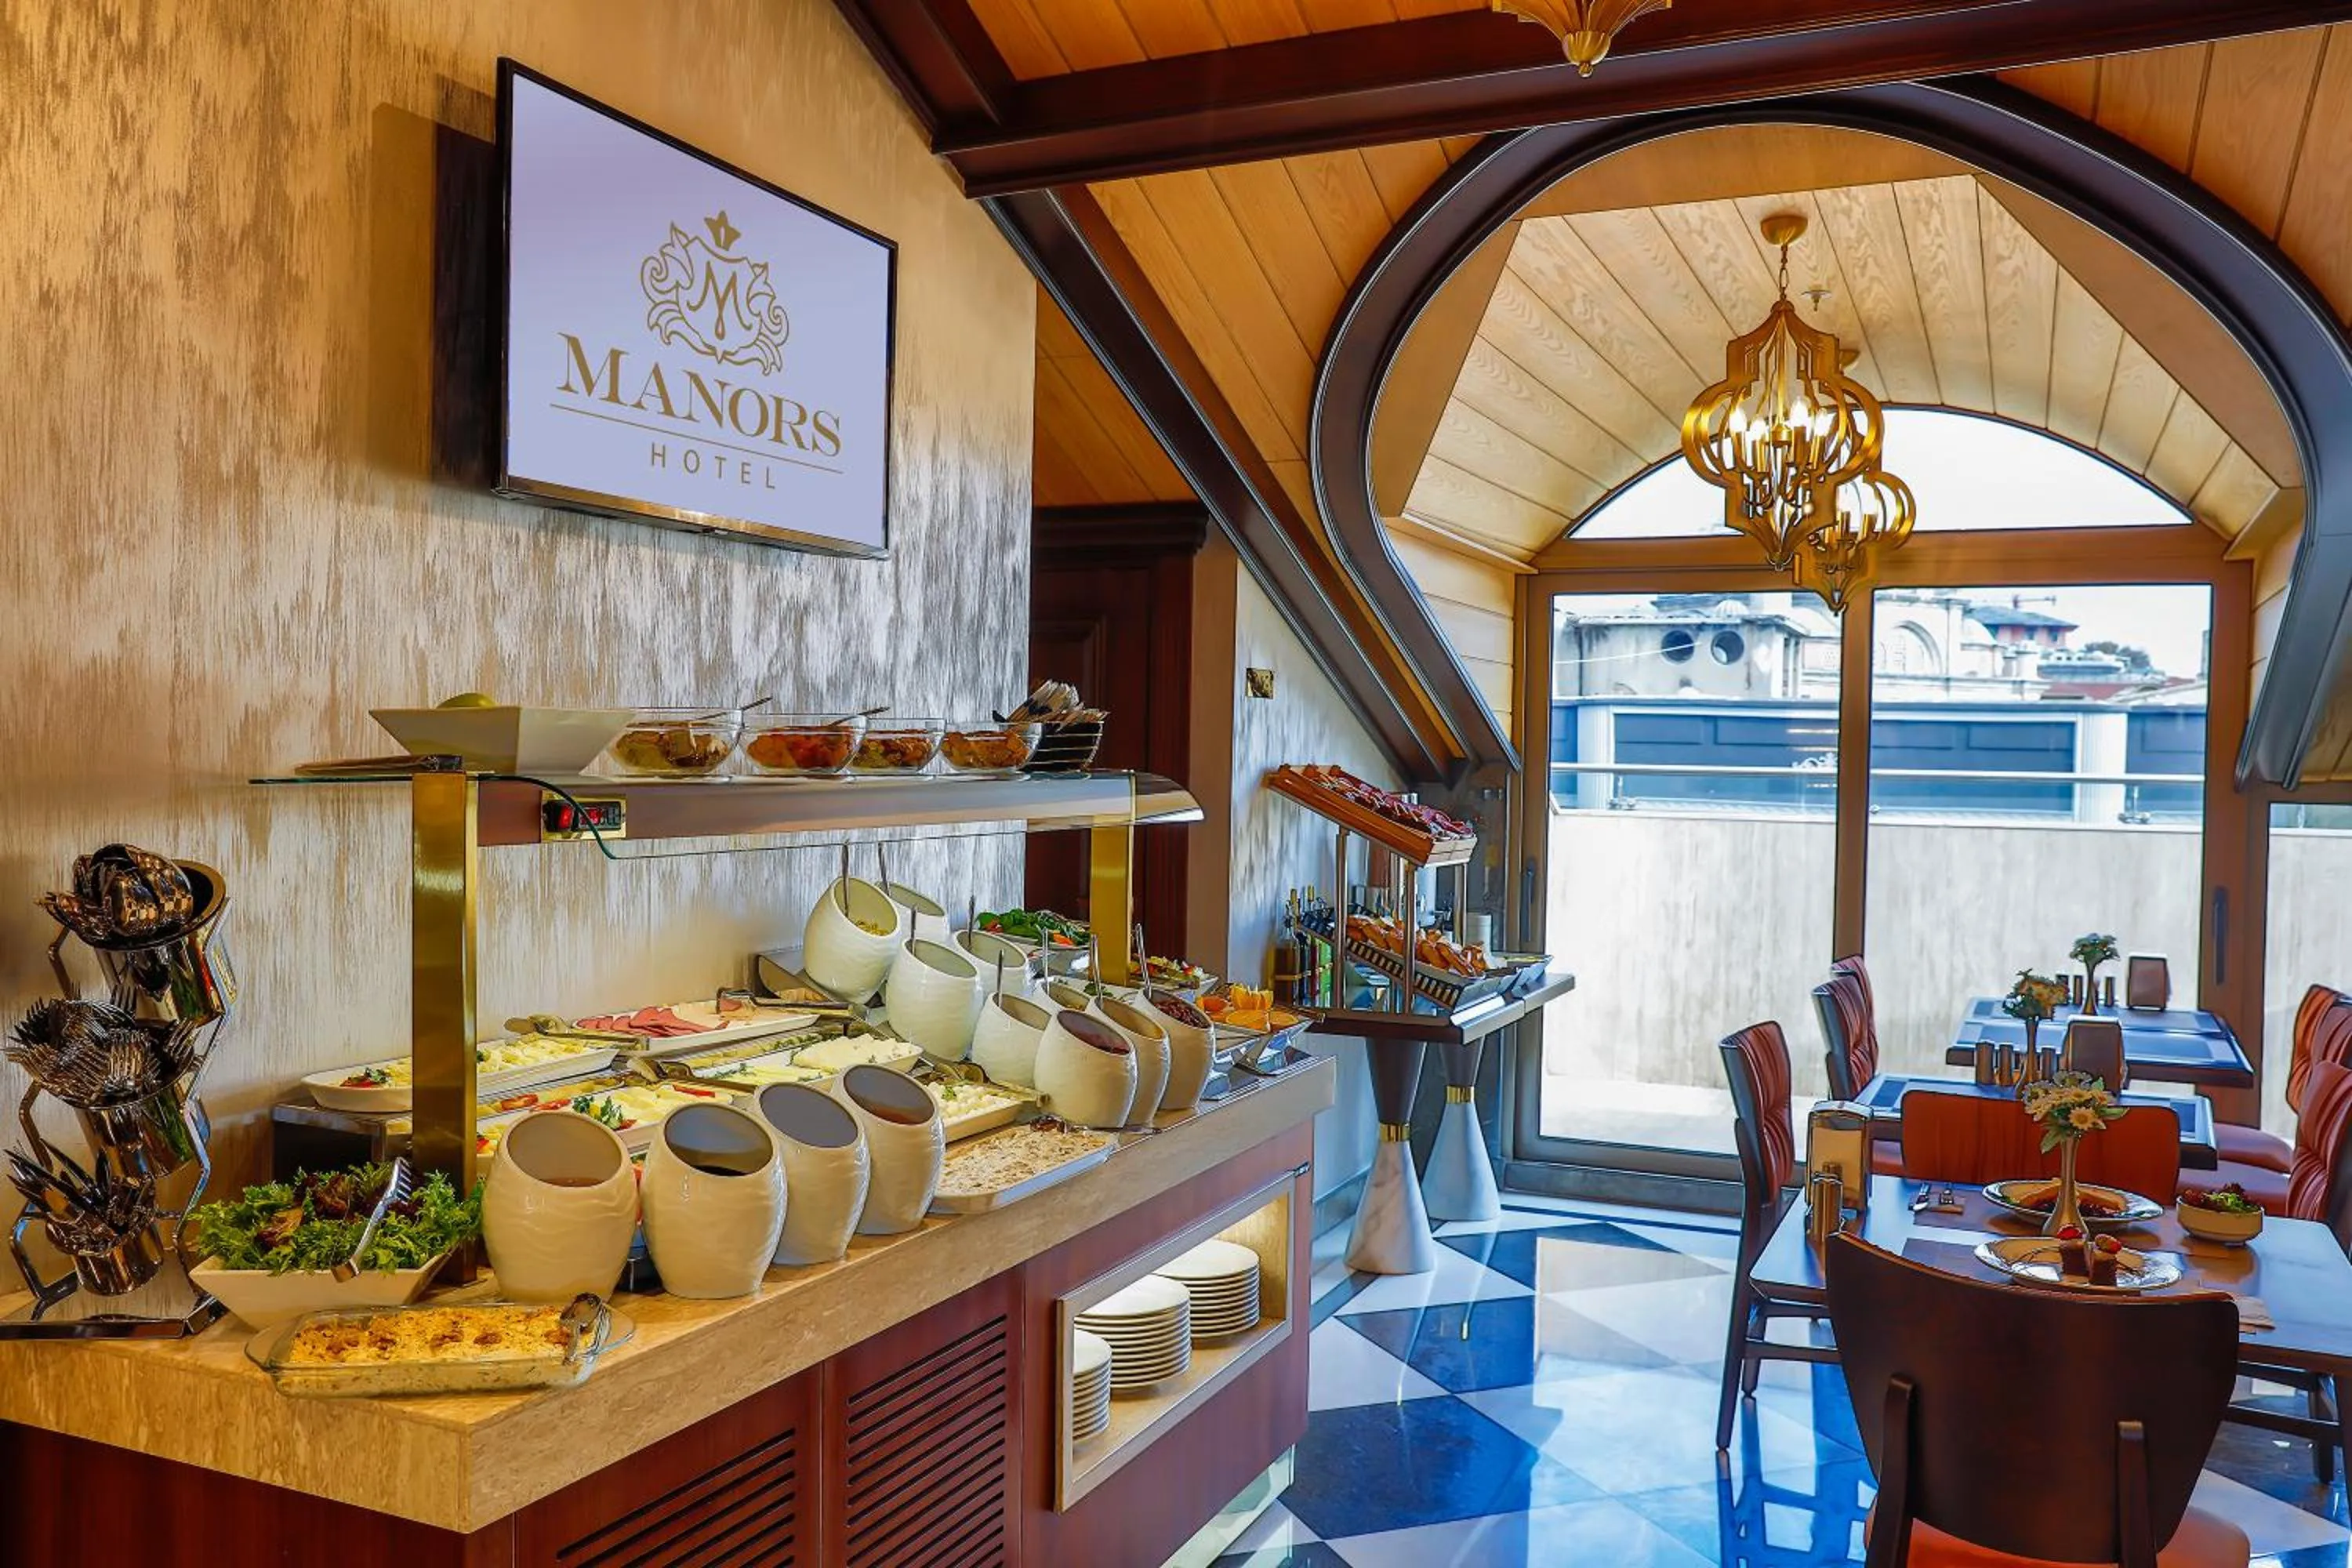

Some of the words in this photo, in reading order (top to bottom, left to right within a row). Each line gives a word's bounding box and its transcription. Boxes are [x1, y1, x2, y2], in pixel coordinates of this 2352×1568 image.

[687, 261, 753, 340] M
[557, 332, 842, 457] MANORS
[652, 442, 776, 489] HOTEL
